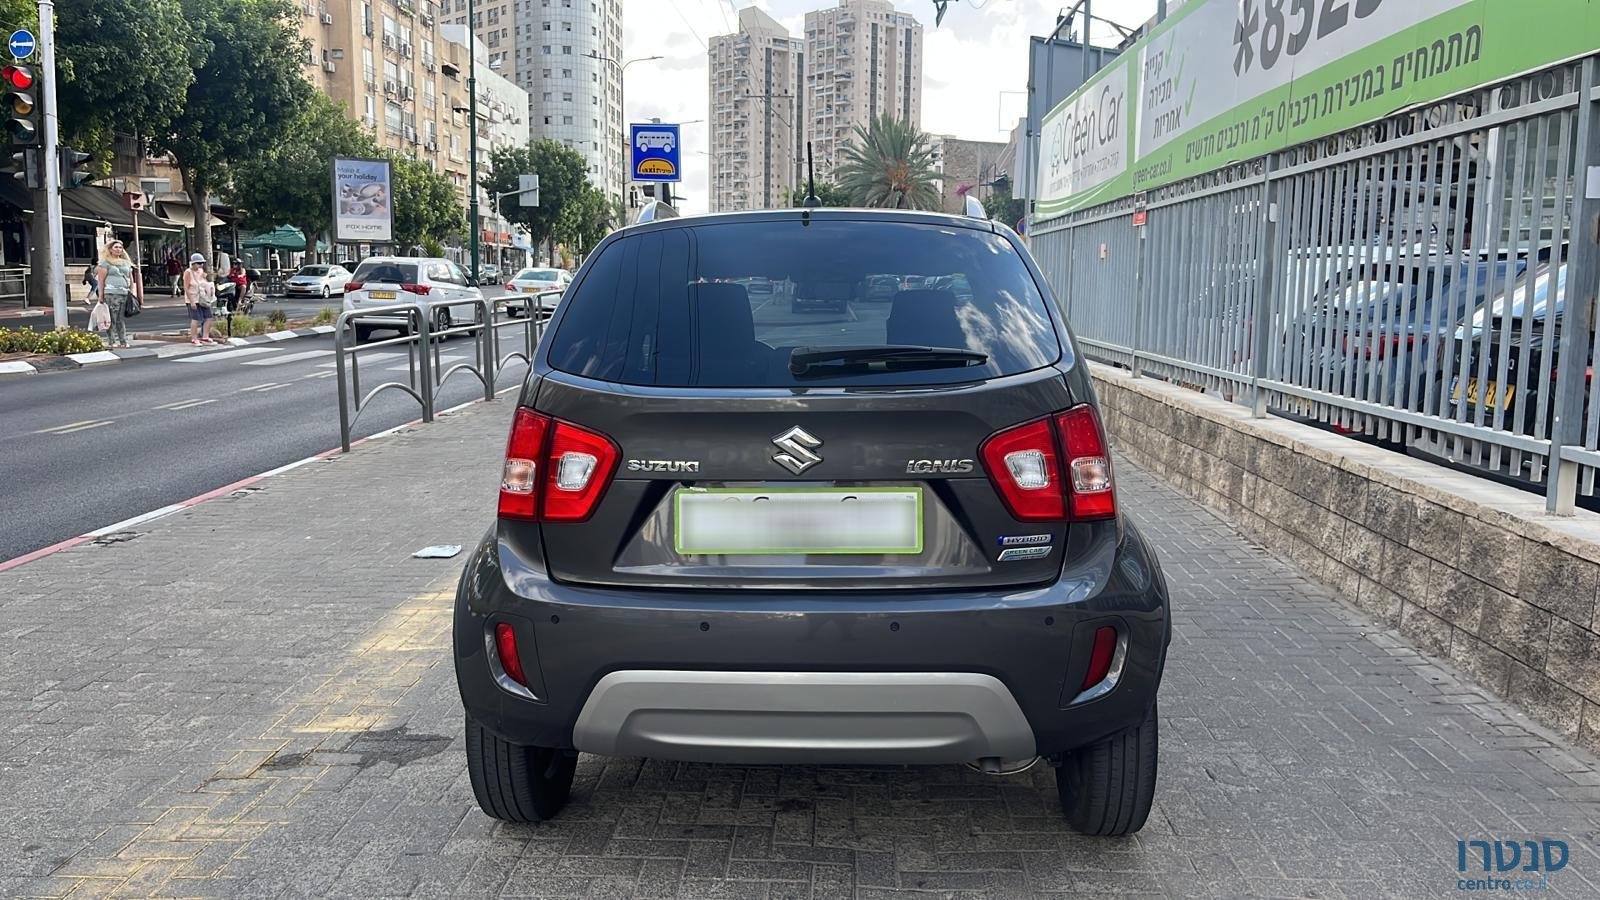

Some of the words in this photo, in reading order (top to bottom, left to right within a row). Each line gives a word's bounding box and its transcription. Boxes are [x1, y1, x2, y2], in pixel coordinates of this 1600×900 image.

[1391, 24, 1481, 91] מתמחים
[1149, 78, 1172, 109] מכירה
[1321, 64, 1385, 117] במכירת
[1063, 110, 1095, 165] Green
[1098, 85, 1123, 146] Car
[1153, 105, 1182, 139] אחריות
[1288, 93, 1318, 127] רכבי
[1186, 134, 1215, 163] חדשים
[1217, 120, 1249, 152] ורכבים
[627, 459, 699, 473] SUZUKI
[905, 459, 976, 474] IGNIS
[1006, 536, 1048, 544] HYBRID
